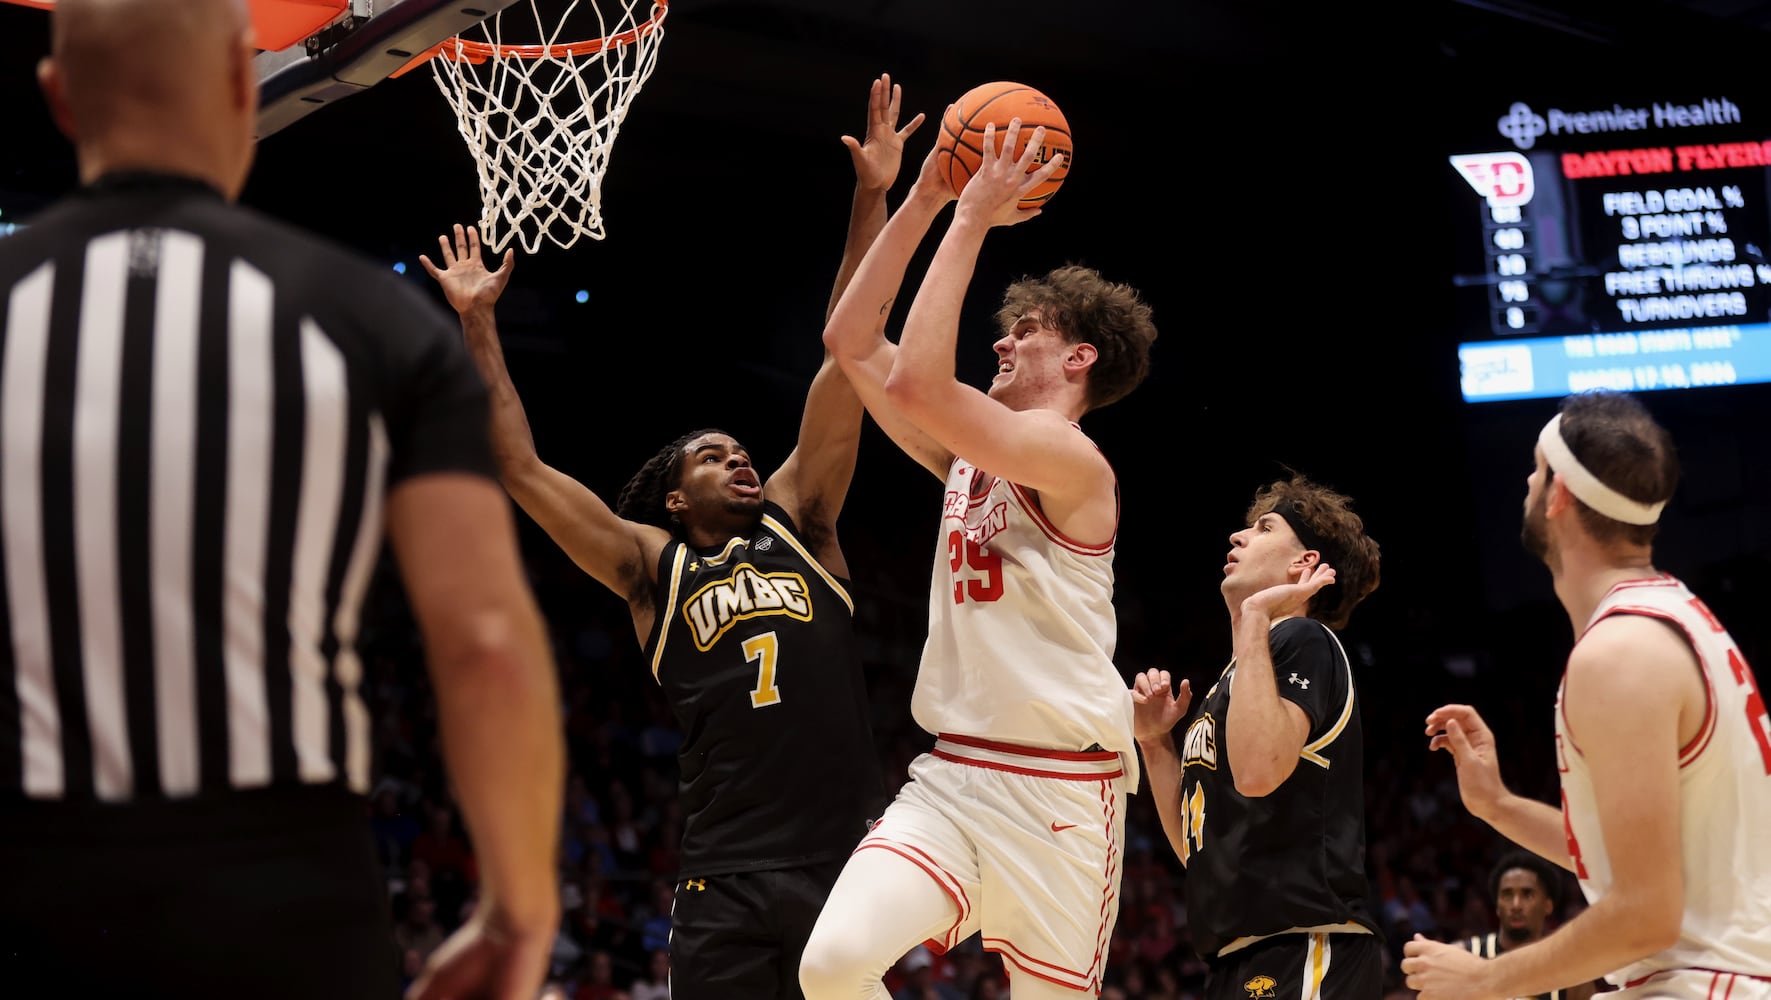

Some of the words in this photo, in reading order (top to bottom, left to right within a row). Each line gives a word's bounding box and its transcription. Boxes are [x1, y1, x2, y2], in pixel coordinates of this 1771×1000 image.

[1548, 103, 1650, 135] Premier
[1653, 96, 1741, 129] Health
[1561, 147, 1673, 179] DAYTON
[1603, 190, 1664, 216] FIELD
[1664, 187, 1723, 212] GOAL
[1640, 212, 1705, 238] POINT
[1618, 238, 1736, 268] REBOUNDS
[1605, 270, 1661, 296] FREE
[1661, 263, 1755, 292] THROWS
[1616, 291, 1747, 323] TURNOVERS
[686, 566, 811, 649] UMBC
[741, 631, 781, 708] 7
[1182, 712, 1217, 770] MBC
